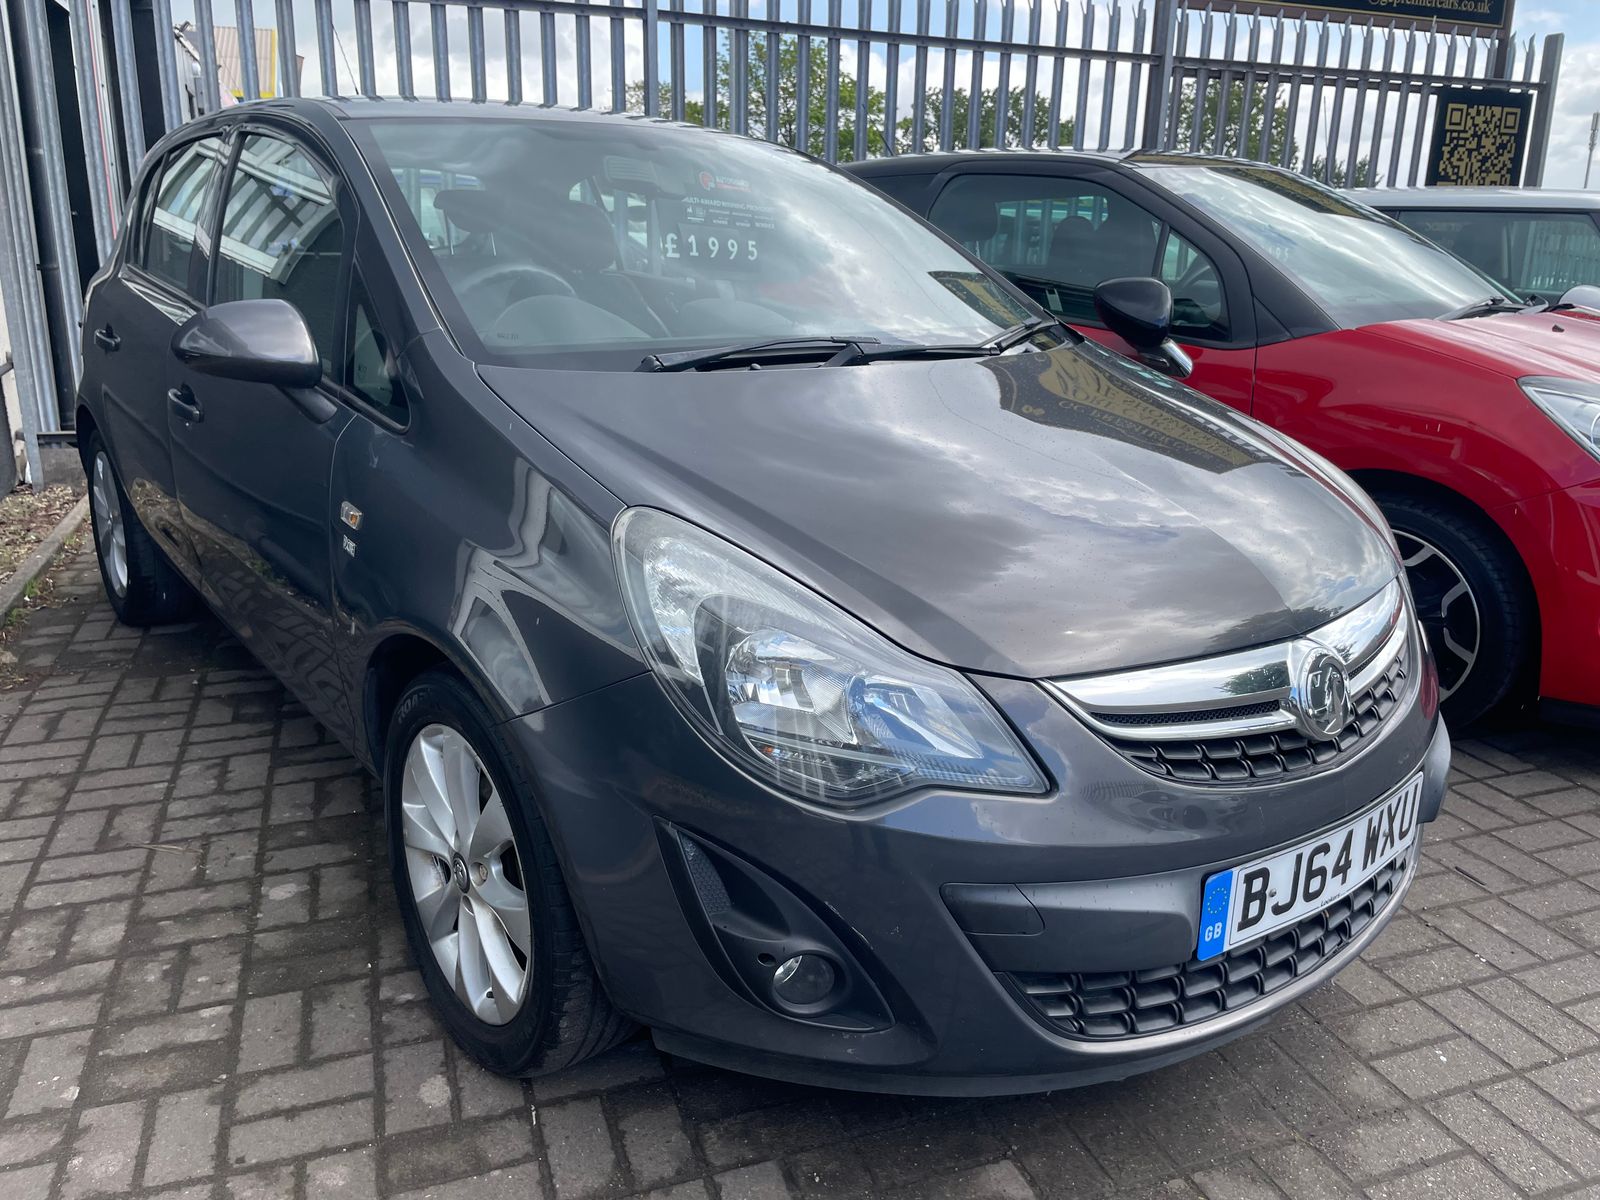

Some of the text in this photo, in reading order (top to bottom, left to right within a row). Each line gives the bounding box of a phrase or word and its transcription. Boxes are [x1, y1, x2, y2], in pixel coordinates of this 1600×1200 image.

[1237, 783, 1419, 932] BJ64 WXU
[1204, 922, 1222, 942] GB
